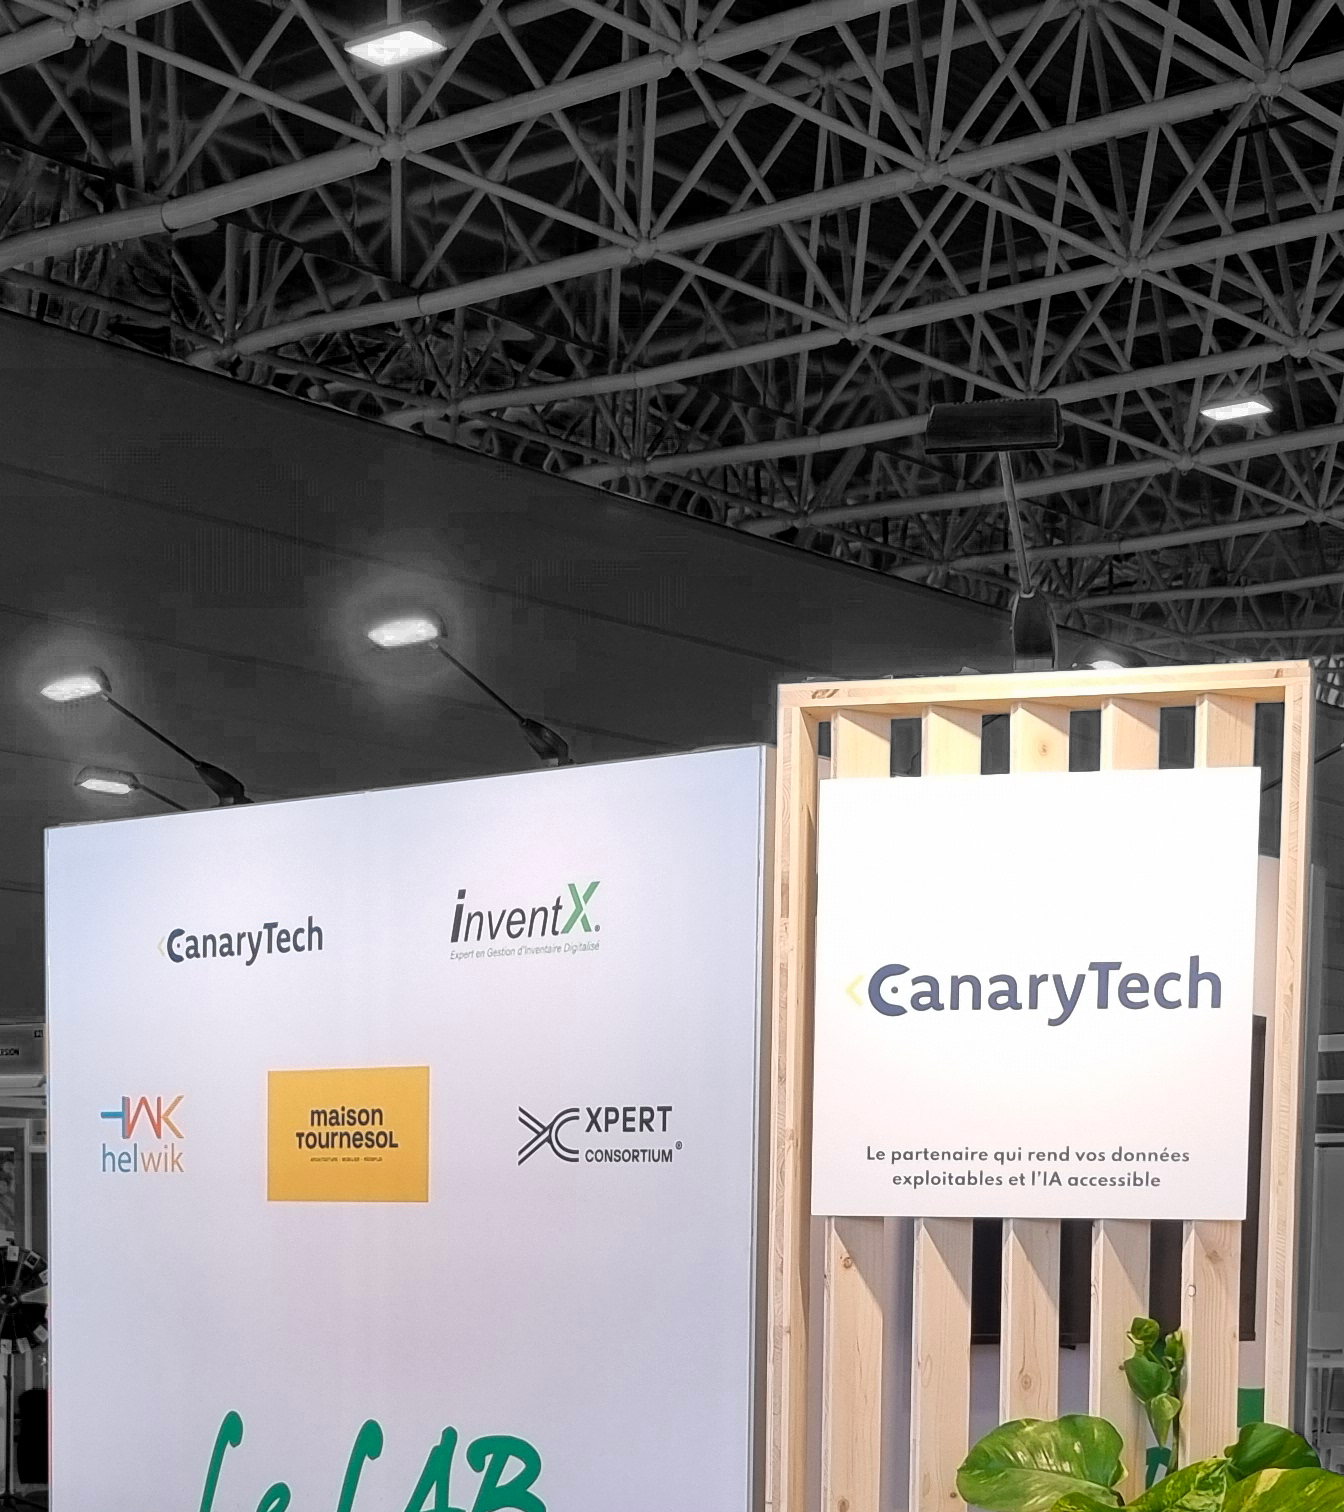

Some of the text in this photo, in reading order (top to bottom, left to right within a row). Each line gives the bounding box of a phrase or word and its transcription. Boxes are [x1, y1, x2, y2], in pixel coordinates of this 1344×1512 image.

[451, 881, 600, 943] inventX
[167, 916, 323, 966] CanaryTech
[868, 955, 1222, 1027] CanaryTech
[310, 1106, 384, 1127] maison
[585, 1106, 673, 1132] XPERT
[102, 1143, 185, 1173] helwik
[585, 1149, 673, 1162] CONSORTIUM
[866, 1145, 1190, 1166] Le partenaire qui rend vos données
[892, 1169, 1003, 1189] exploitables
[1008, 1172, 1026, 1186] et
[1067, 1170, 1161, 1187] accessible
